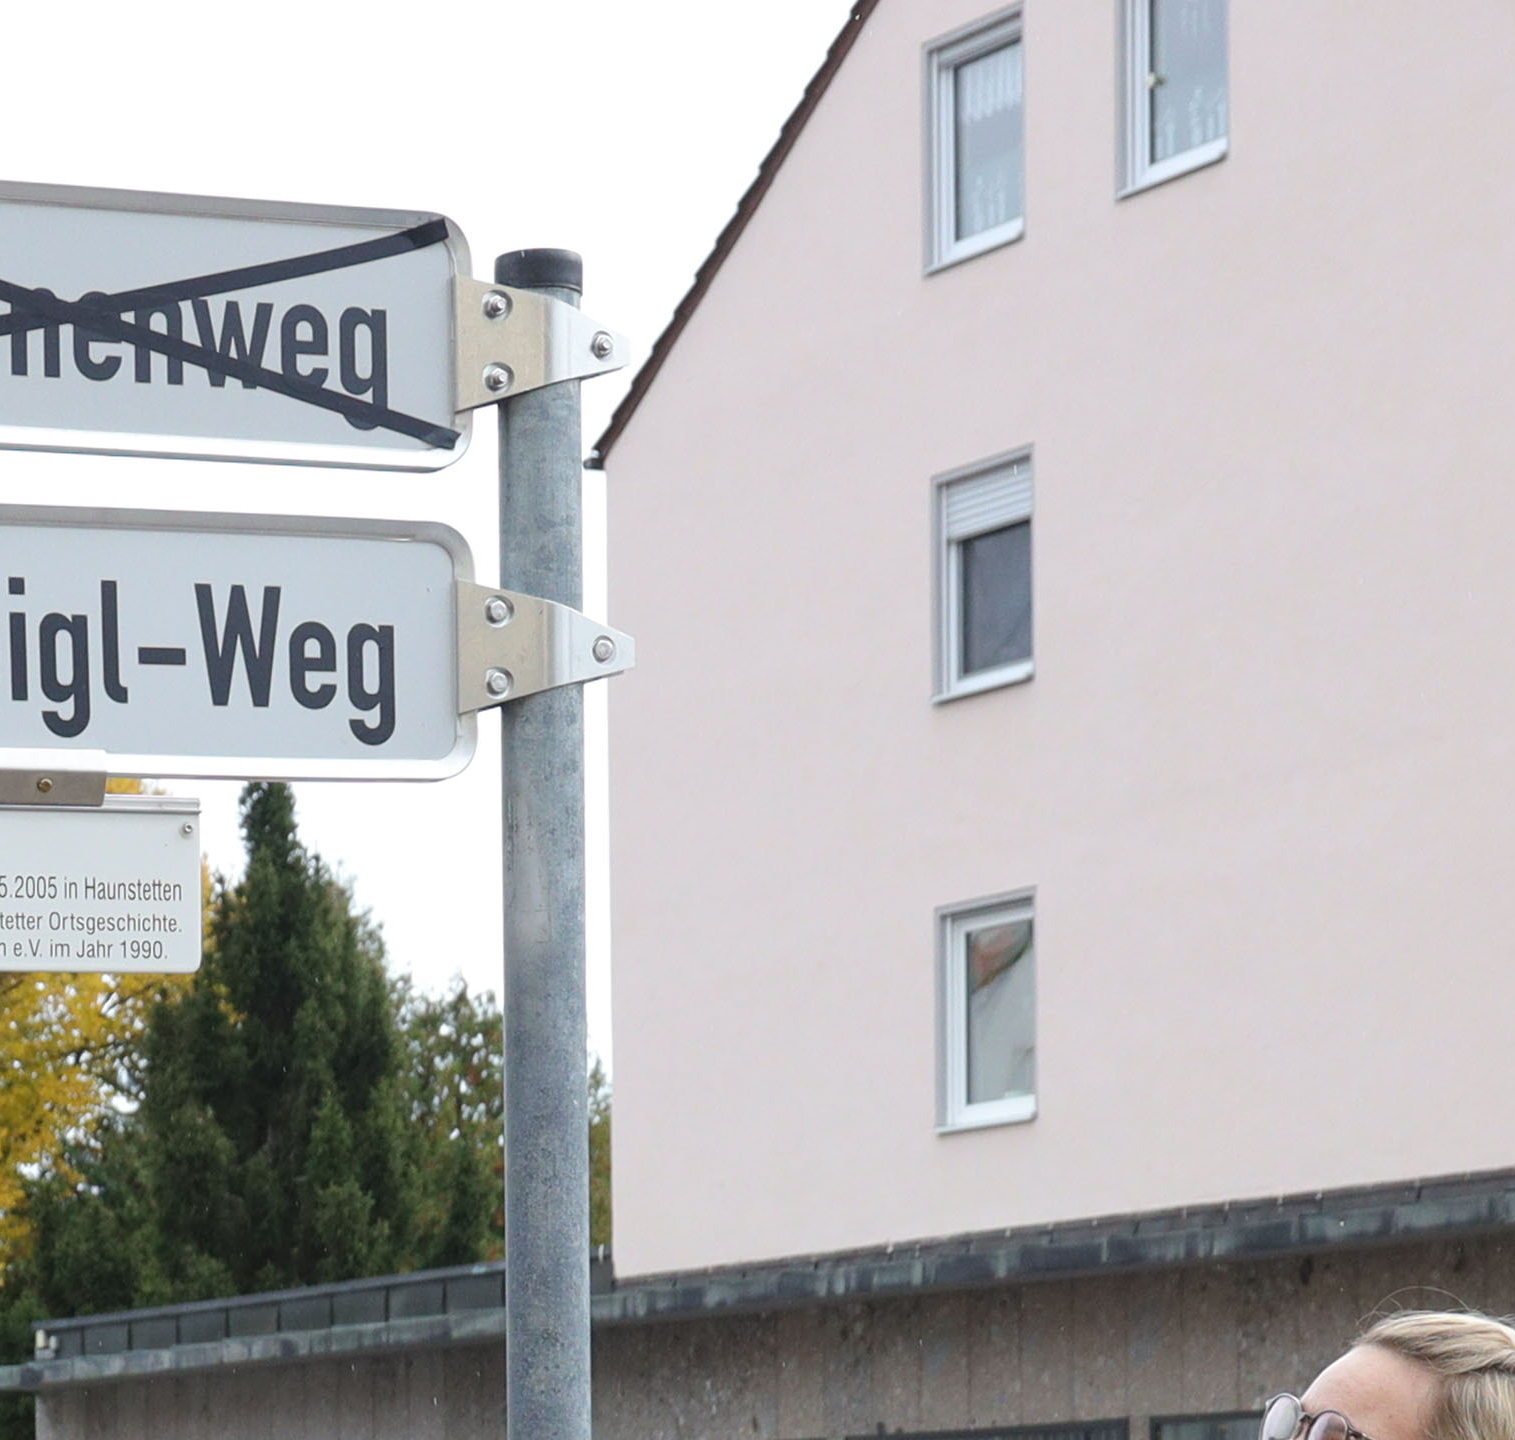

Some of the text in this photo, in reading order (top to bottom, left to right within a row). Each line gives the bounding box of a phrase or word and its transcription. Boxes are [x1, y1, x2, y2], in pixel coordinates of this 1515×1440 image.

[64, 876, 78, 899] in
[84, 878, 182, 902] Haunstetten
[48, 911, 183, 936] Ortsgeschichte.
[13, 939, 43, 958] e.V.
[50, 939, 70, 957] im
[76, 940, 113, 959] Jahr
[120, 940, 169, 960] 1990.
